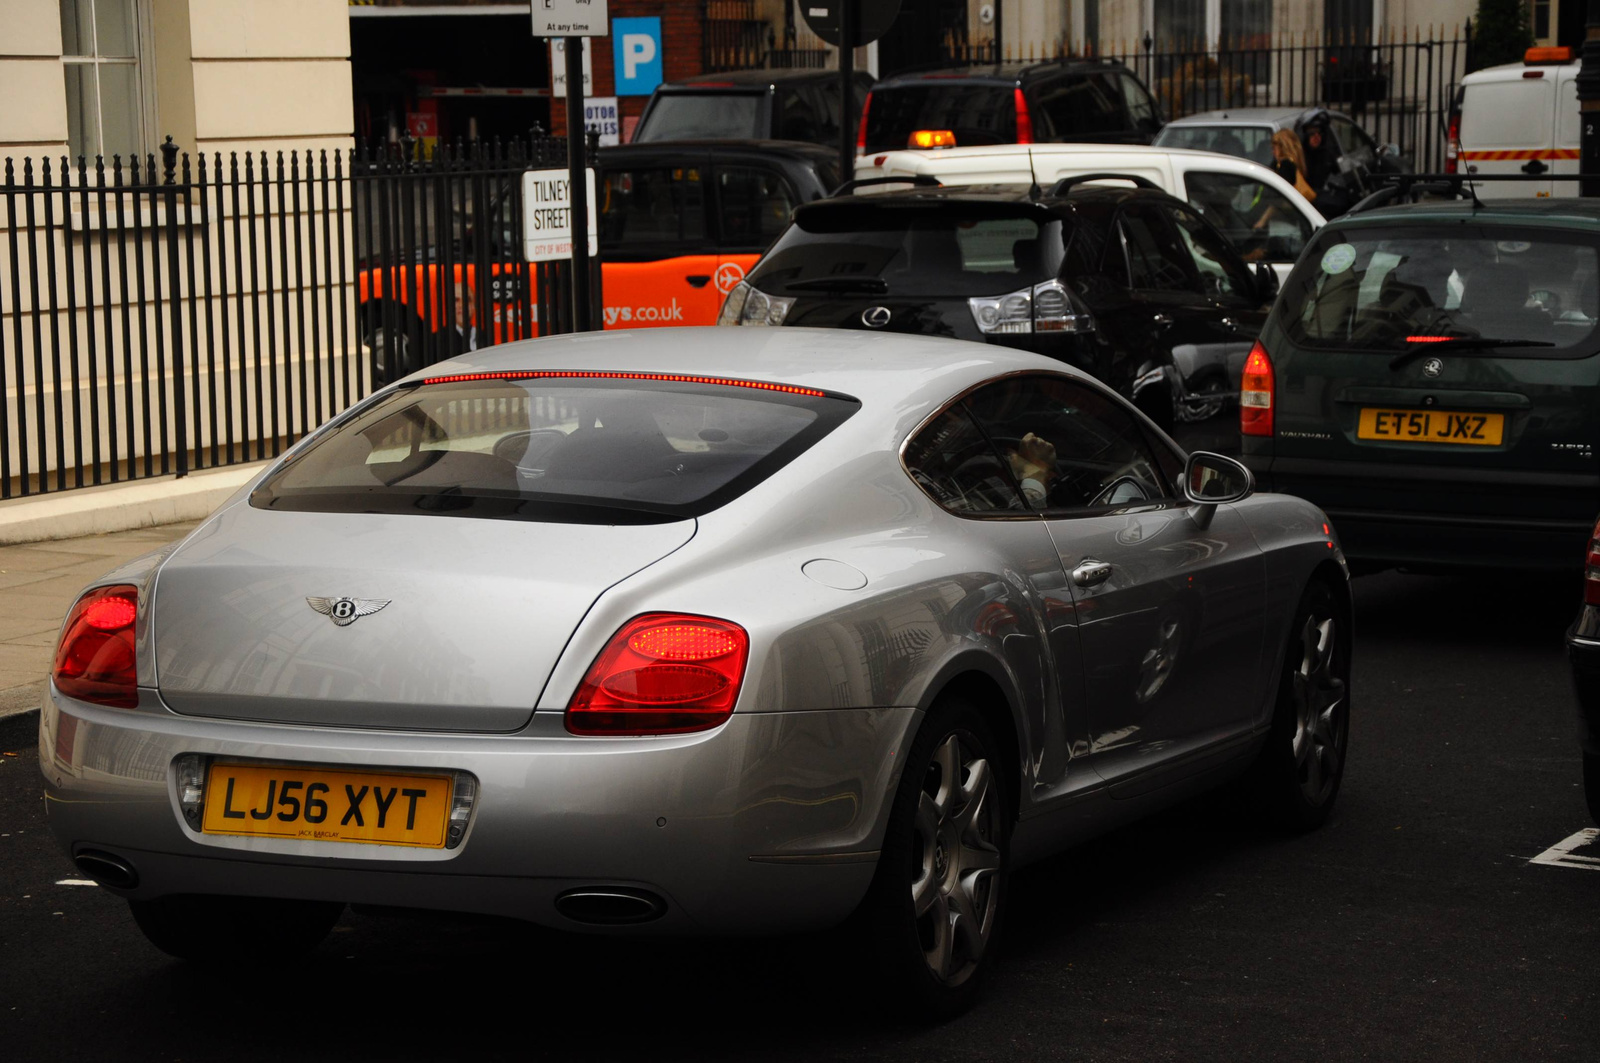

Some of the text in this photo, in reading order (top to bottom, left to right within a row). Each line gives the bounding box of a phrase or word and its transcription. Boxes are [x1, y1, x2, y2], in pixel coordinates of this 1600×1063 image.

[547, 23, 589, 32] At any time
[622, 33, 656, 79] P
[586, 106, 615, 119] OTOR
[1586, 124, 1594, 135] 2
[533, 180, 571, 202] TILNEY
[534, 207, 571, 230] STREET
[535, 244, 546, 255] CITY
[547, 244, 554, 254] OF
[1375, 412, 1487, 439] ET51 JXZ
[223, 777, 427, 830] LJ56 XYT
[298, 829, 312, 837] JACK
[313, 830, 340, 838] BARCLAY
